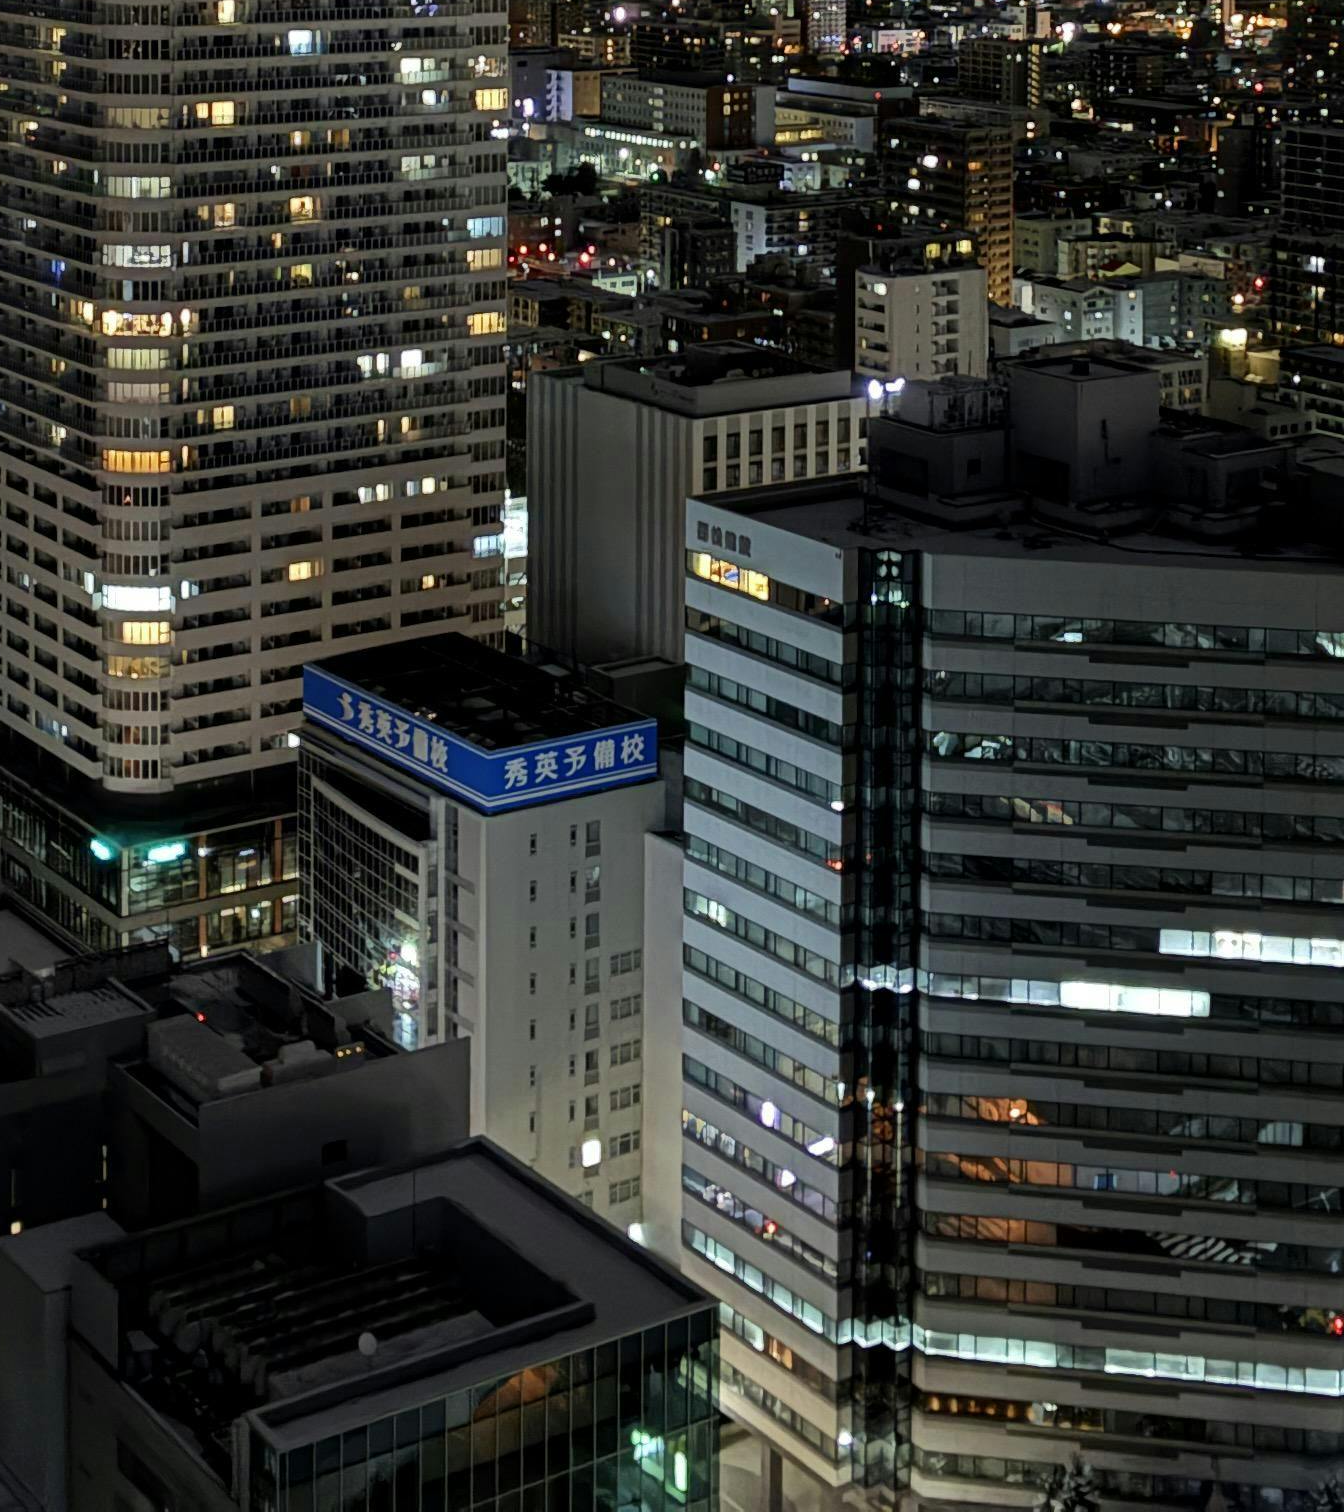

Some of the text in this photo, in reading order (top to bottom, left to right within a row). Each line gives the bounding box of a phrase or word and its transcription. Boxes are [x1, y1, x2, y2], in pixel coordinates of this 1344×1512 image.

[357, 701, 449, 774] 秀英予備校
[504, 733, 645, 790] 秀英予備校
